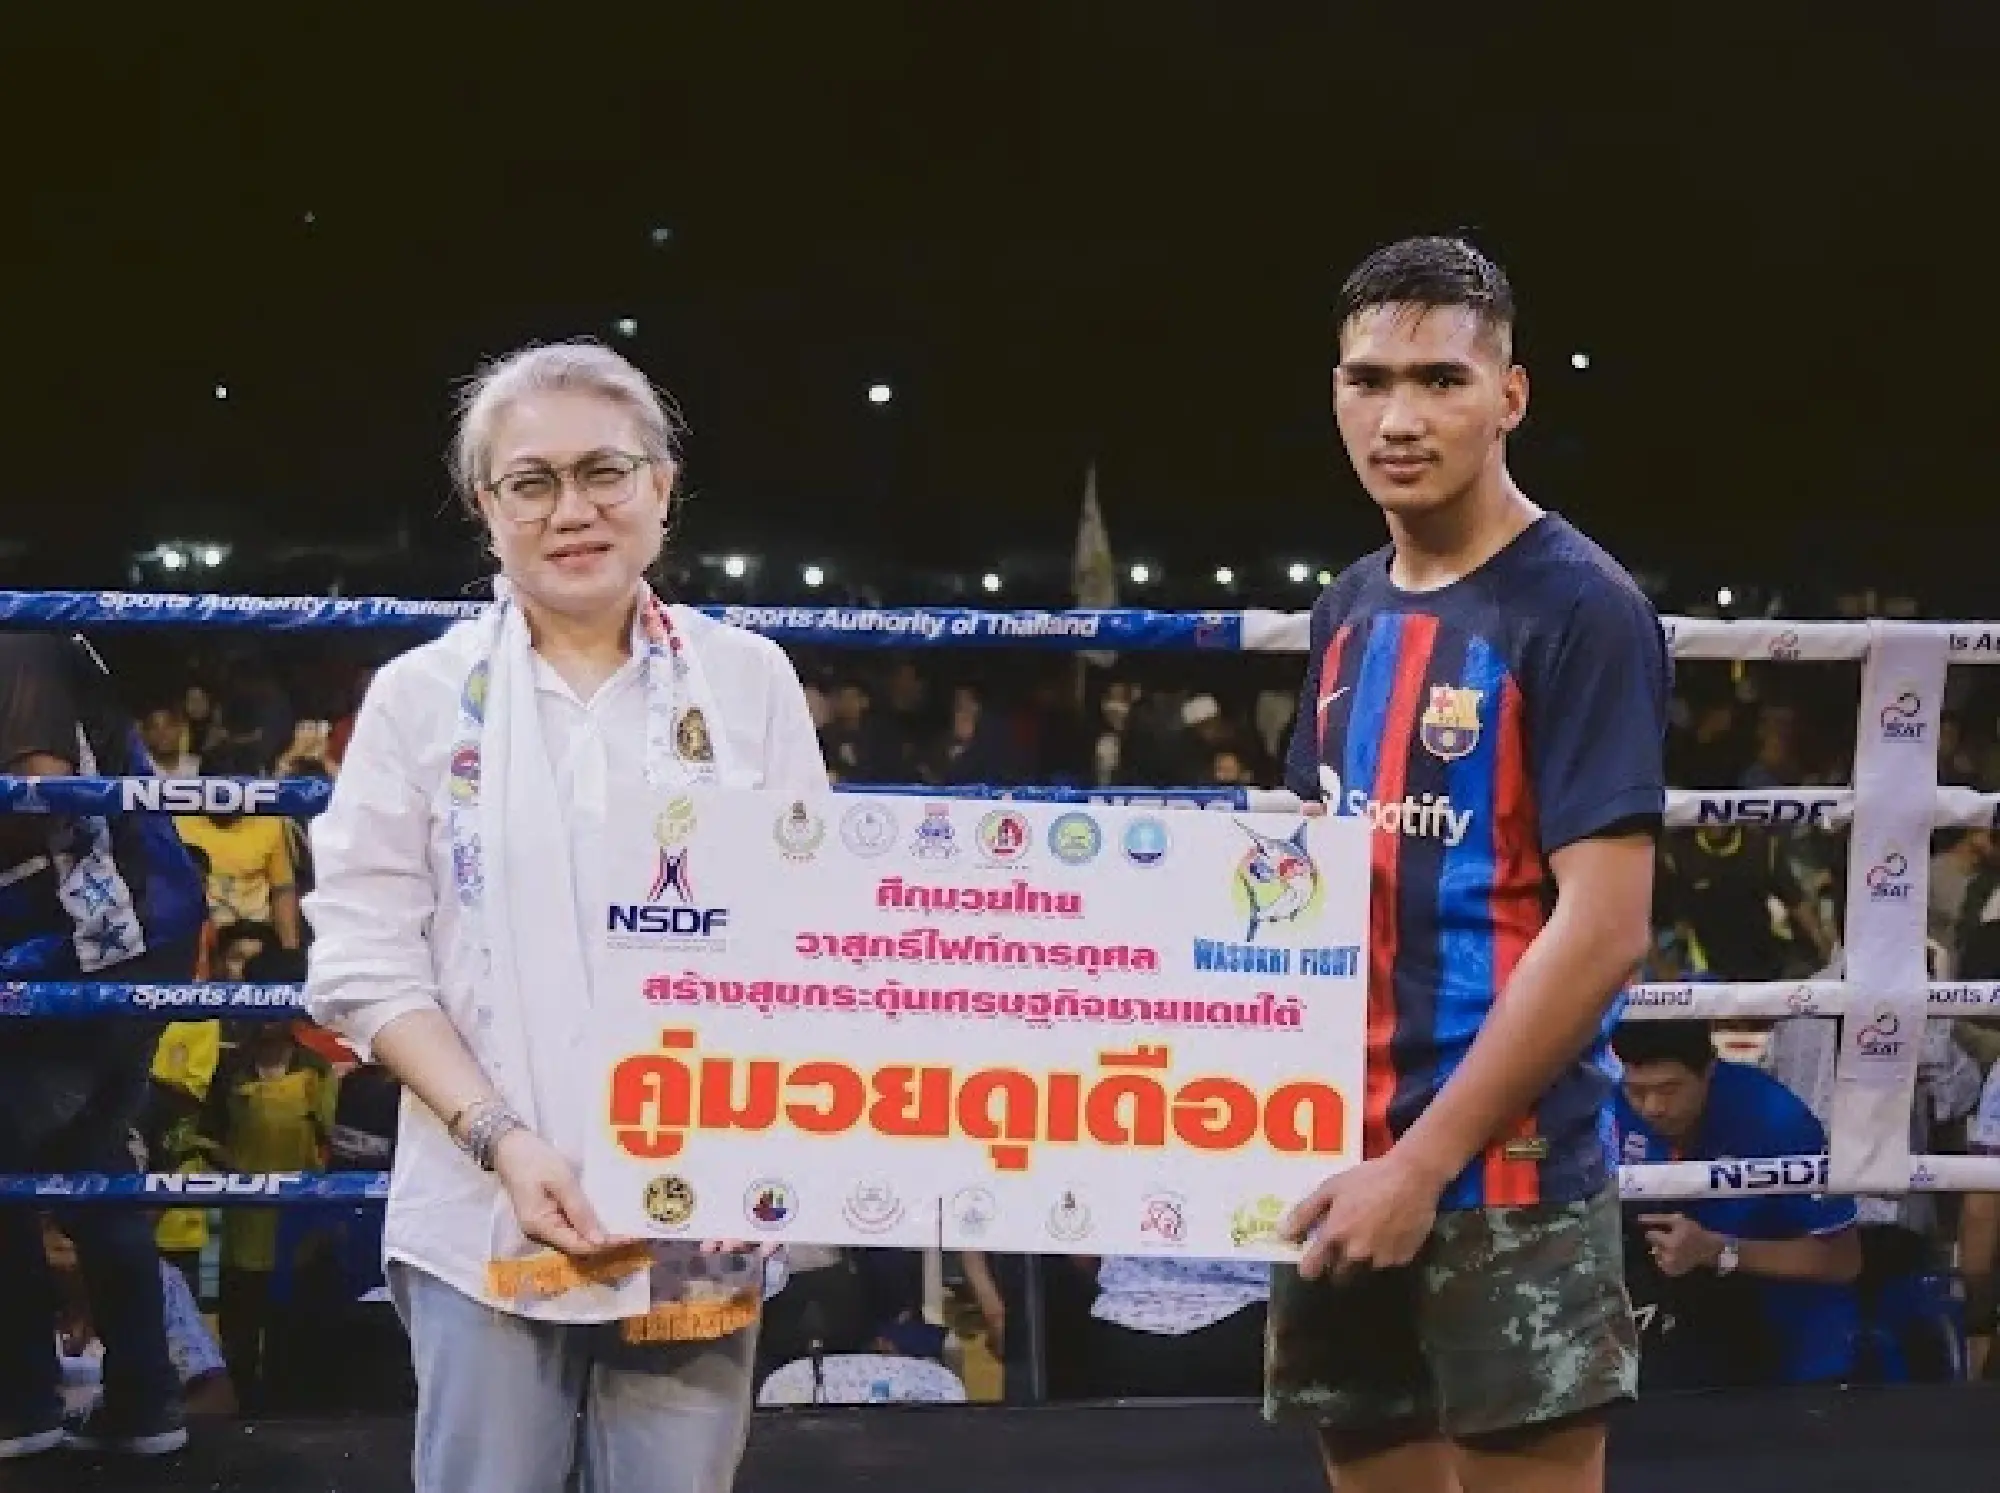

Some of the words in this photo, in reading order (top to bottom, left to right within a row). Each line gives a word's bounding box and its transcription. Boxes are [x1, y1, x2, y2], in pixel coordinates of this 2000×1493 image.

[100, 591, 193, 611] Sports
[724, 606, 814, 630] Sports
[818, 607, 946, 639] Authority
[951, 609, 980, 636] of
[983, 610, 1099, 638] Thailand
[121, 779, 280, 813] NSDF
[875, 875, 1083, 916] ศึกมวยไทย
[606, 905, 729, 936] NSDF
[1299, 944, 1361, 976] FIGHT
[132, 983, 227, 1010] Sports
[608, 1028, 1346, 1171] คู่มวยดุเดือด
